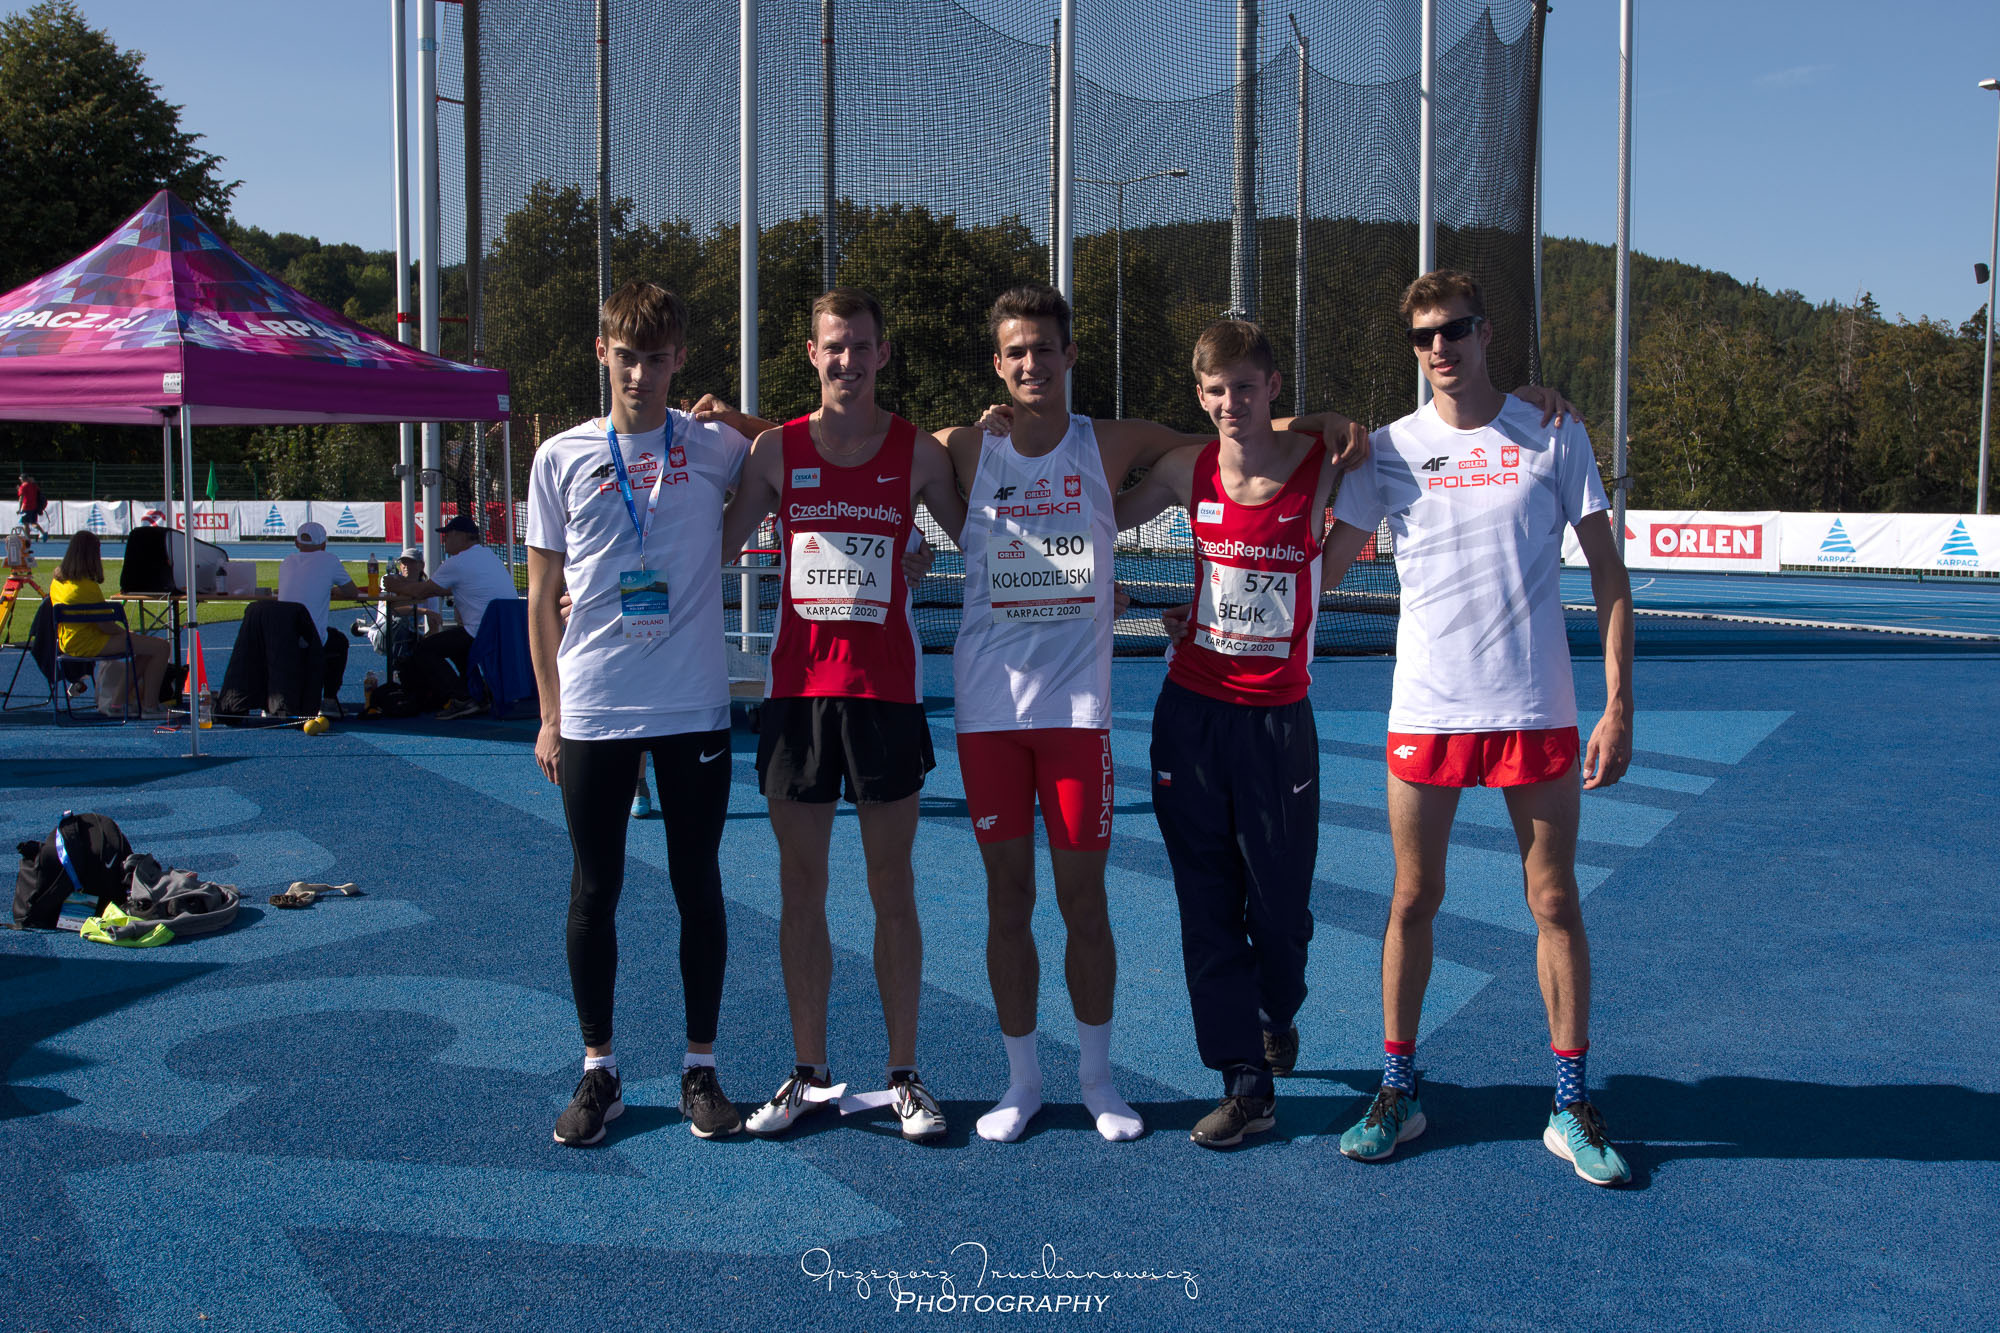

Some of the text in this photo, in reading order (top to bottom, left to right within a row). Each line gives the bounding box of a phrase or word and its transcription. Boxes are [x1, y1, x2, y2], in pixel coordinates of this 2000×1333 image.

[629, 462, 656, 472] ORLEN
[1421, 456, 1449, 471] 4F
[1459, 461, 1486, 469] ORLEN
[1428, 472, 1519, 490] POLSKA
[1025, 490, 1050, 498] ORLEN
[789, 500, 902, 525] CzechRepublic
[997, 501, 1081, 519] POLSKA
[845, 536, 886, 559] 576
[1042, 535, 1085, 557] 180
[1196, 536, 1305, 562] CzechRepublic
[1655, 527, 1755, 554] ORLEN
[999, 551, 1024, 559] ORLEN
[1817, 555, 1857, 563] KARPACZ
[1936, 558, 1980, 567] KARPACZ
[806, 569, 877, 588] STEFELA
[992, 568, 1092, 589] KOŁODZIEJSKI
[1244, 573, 1289, 596] 574
[806, 606, 878, 618] KARPACZ 2020
[1006, 605, 1081, 619] KARPACZ 2020
[1218, 602, 1266, 623] BELIK
[1205, 634, 1248, 651] KARPACZ
[1250, 643, 1275, 652] 2020
[1393, 744, 1417, 760] 4F
[1097, 734, 1112, 838] POLSKA
[976, 815, 999, 830] 4F
